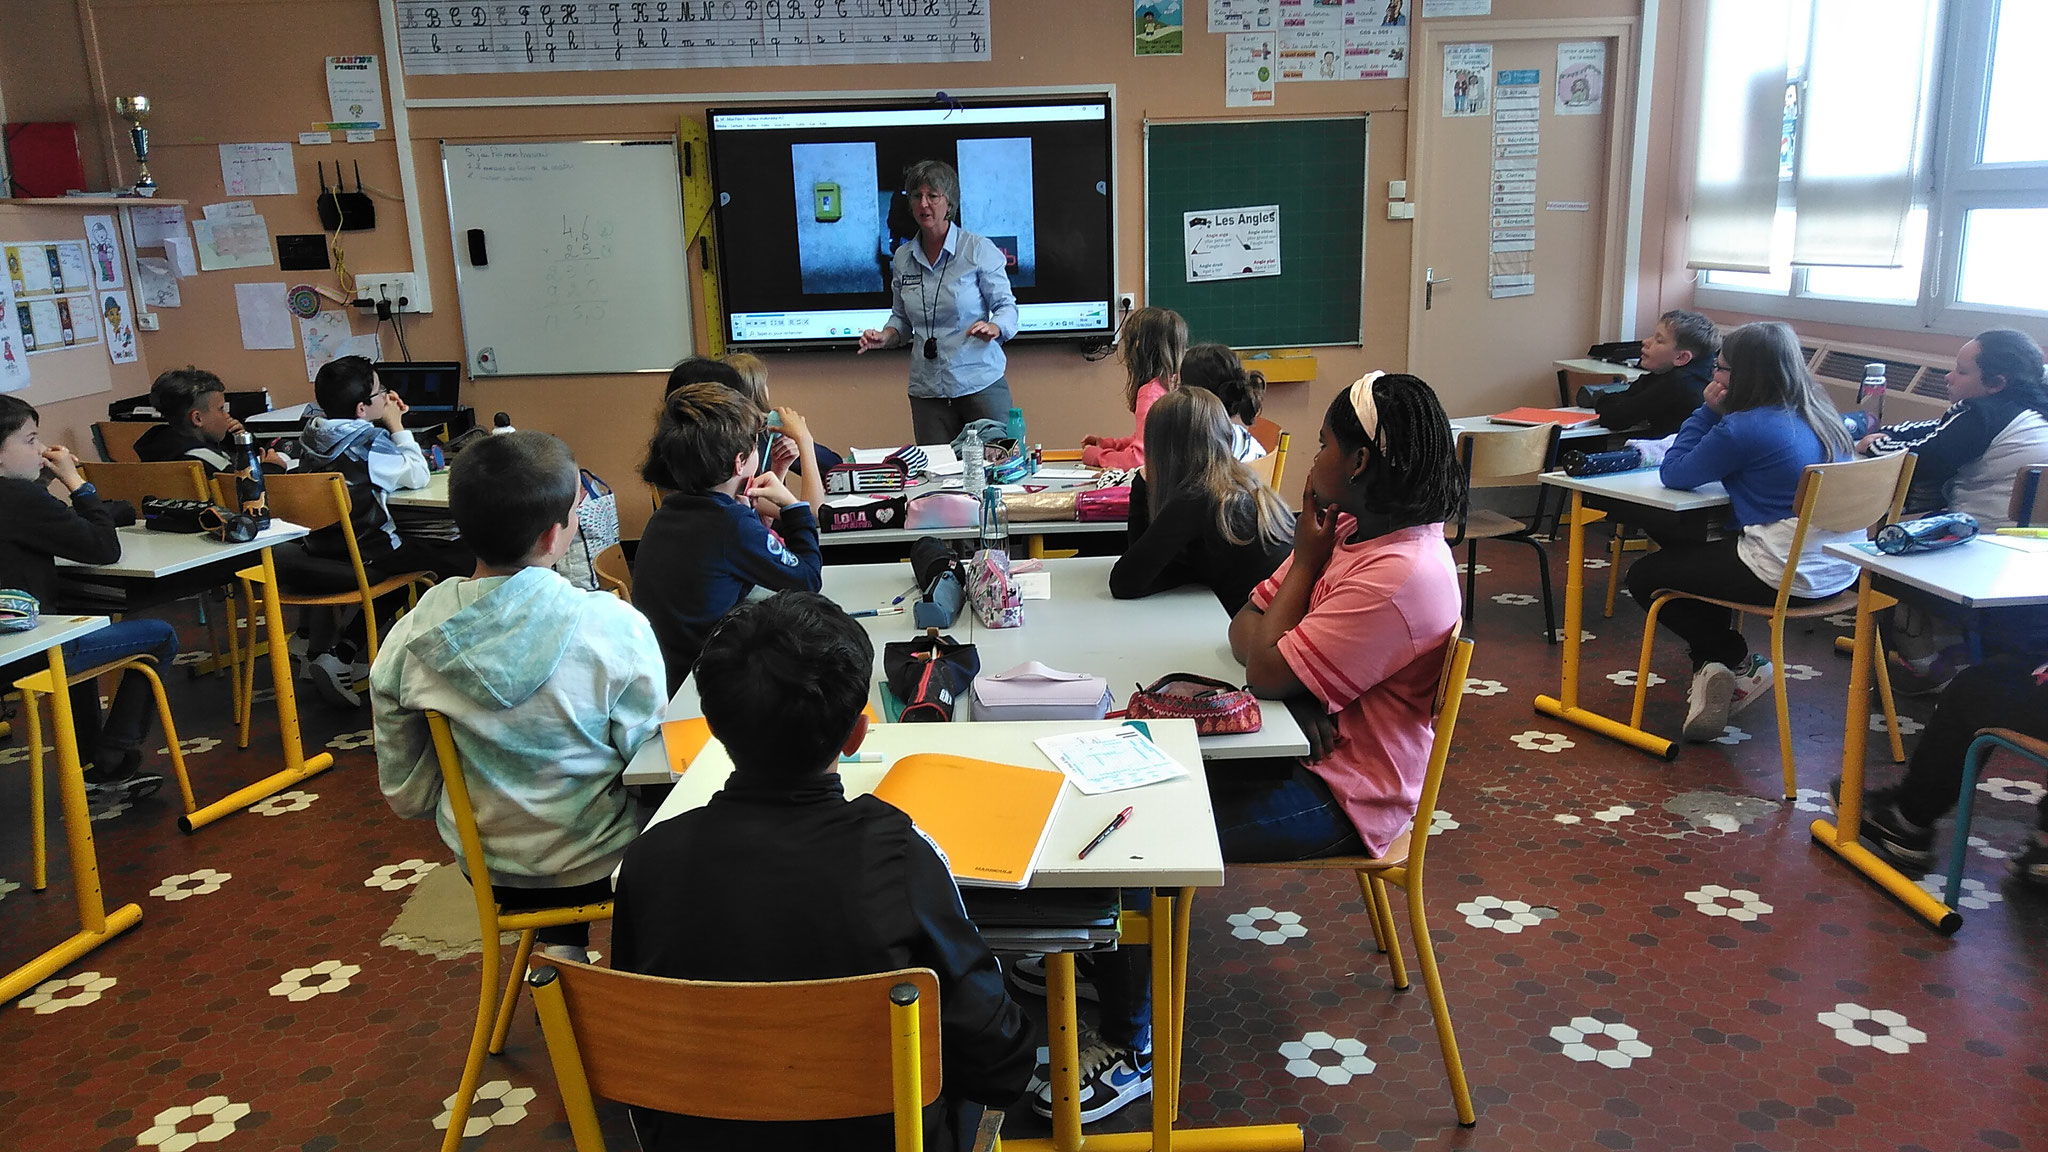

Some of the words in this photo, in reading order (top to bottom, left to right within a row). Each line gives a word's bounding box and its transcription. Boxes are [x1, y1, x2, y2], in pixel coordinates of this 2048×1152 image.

[425, 8, 441, 27] B
[450, 6, 462, 26] C
[472, 7, 486, 26] D
[519, 5, 530, 25] F
[540, 5, 555, 37] G
[561, 4, 578, 24] H
[609, 4, 621, 35] J
[631, 3, 649, 22] K
[656, 3, 670, 21] L
[677, 1, 695, 21] M
[700, 1, 714, 20] N
[745, 1, 757, 20] P
[767, 0, 780, 31] Q
[788, 0, 805, 19] R
[814, 0, 824, 18] S
[837, 0, 847, 17] T
[880, 0, 892, 16] V
[900, 0, 916, 16] W
[924, 0, 940, 15] X
[968, 0, 980, 15] Z
[431, 33, 441, 53] b
[455, 44, 463, 52] c
[478, 38, 488, 52] d
[525, 31, 533, 63] f
[545, 42, 556, 62] g
[568, 30, 578, 49] h
[615, 39, 622, 61] j
[637, 28, 647, 47] k
[661, 27, 669, 47] l
[705, 38, 715, 46] n
[750, 38, 758, 58] p
[771, 37, 780, 57] q
[794, 36, 802, 44] r
[817, 35, 825, 43] s
[839, 29, 846, 42] t
[883, 34, 891, 42] v
[971, 32, 980, 52] z
[1215, 215, 1234, 226] Les
[1238, 211, 1275, 226] Angles
[833, 511, 867, 525] LOLA
